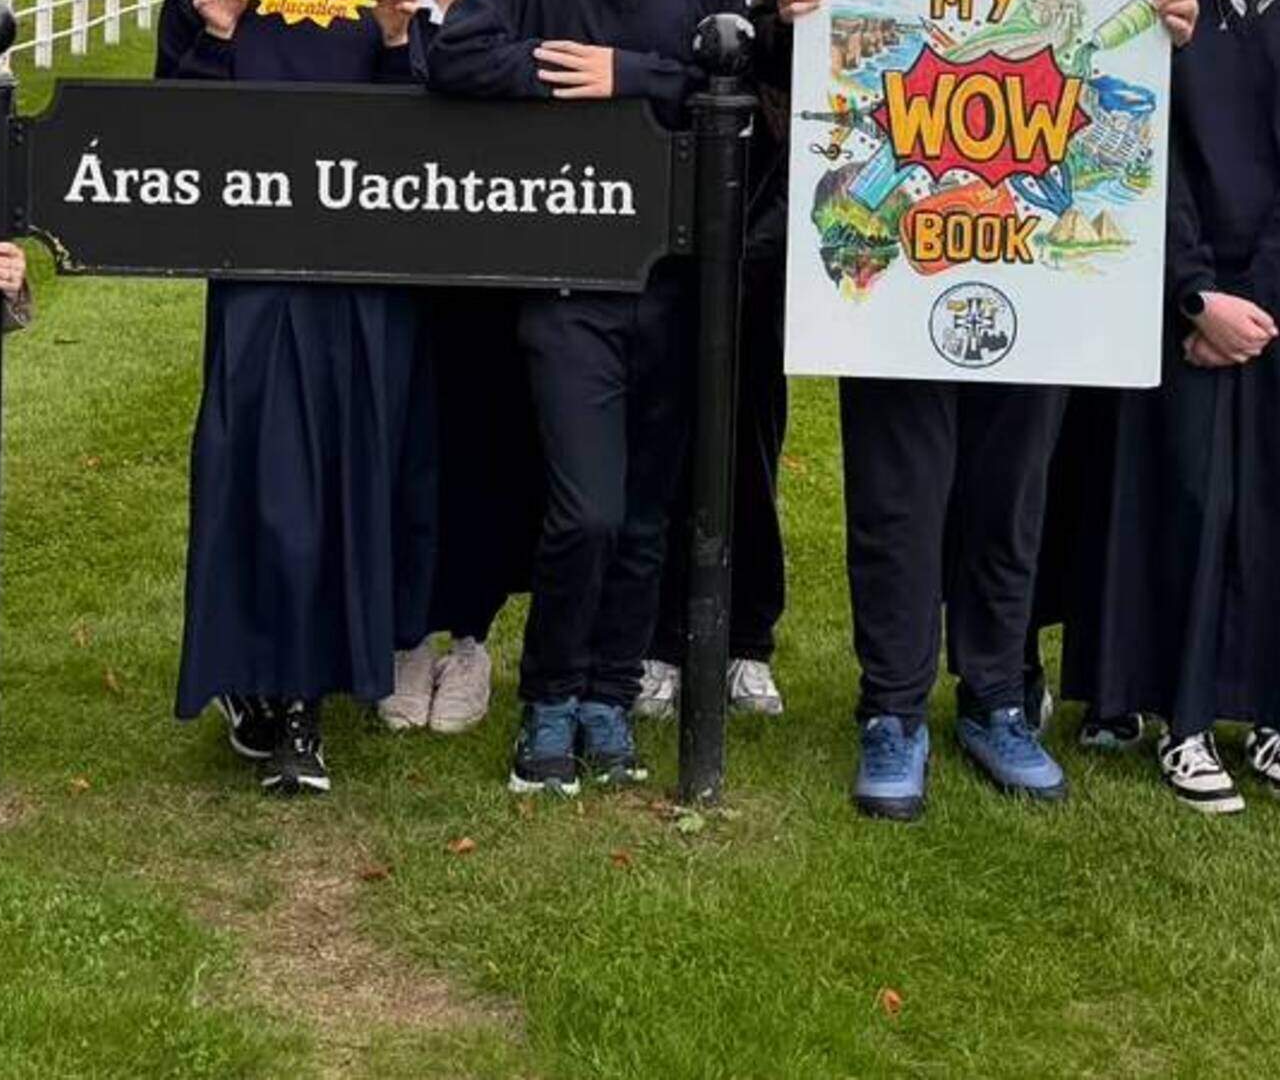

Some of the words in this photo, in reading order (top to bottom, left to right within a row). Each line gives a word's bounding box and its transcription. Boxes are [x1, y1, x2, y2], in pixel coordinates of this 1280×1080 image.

[882, 71, 1082, 164] WOW
[64, 140, 201, 205] Áras
[222, 169, 293, 207] an
[315, 159, 637, 216] Uachtaráin
[910, 211, 1039, 265] BOOK
